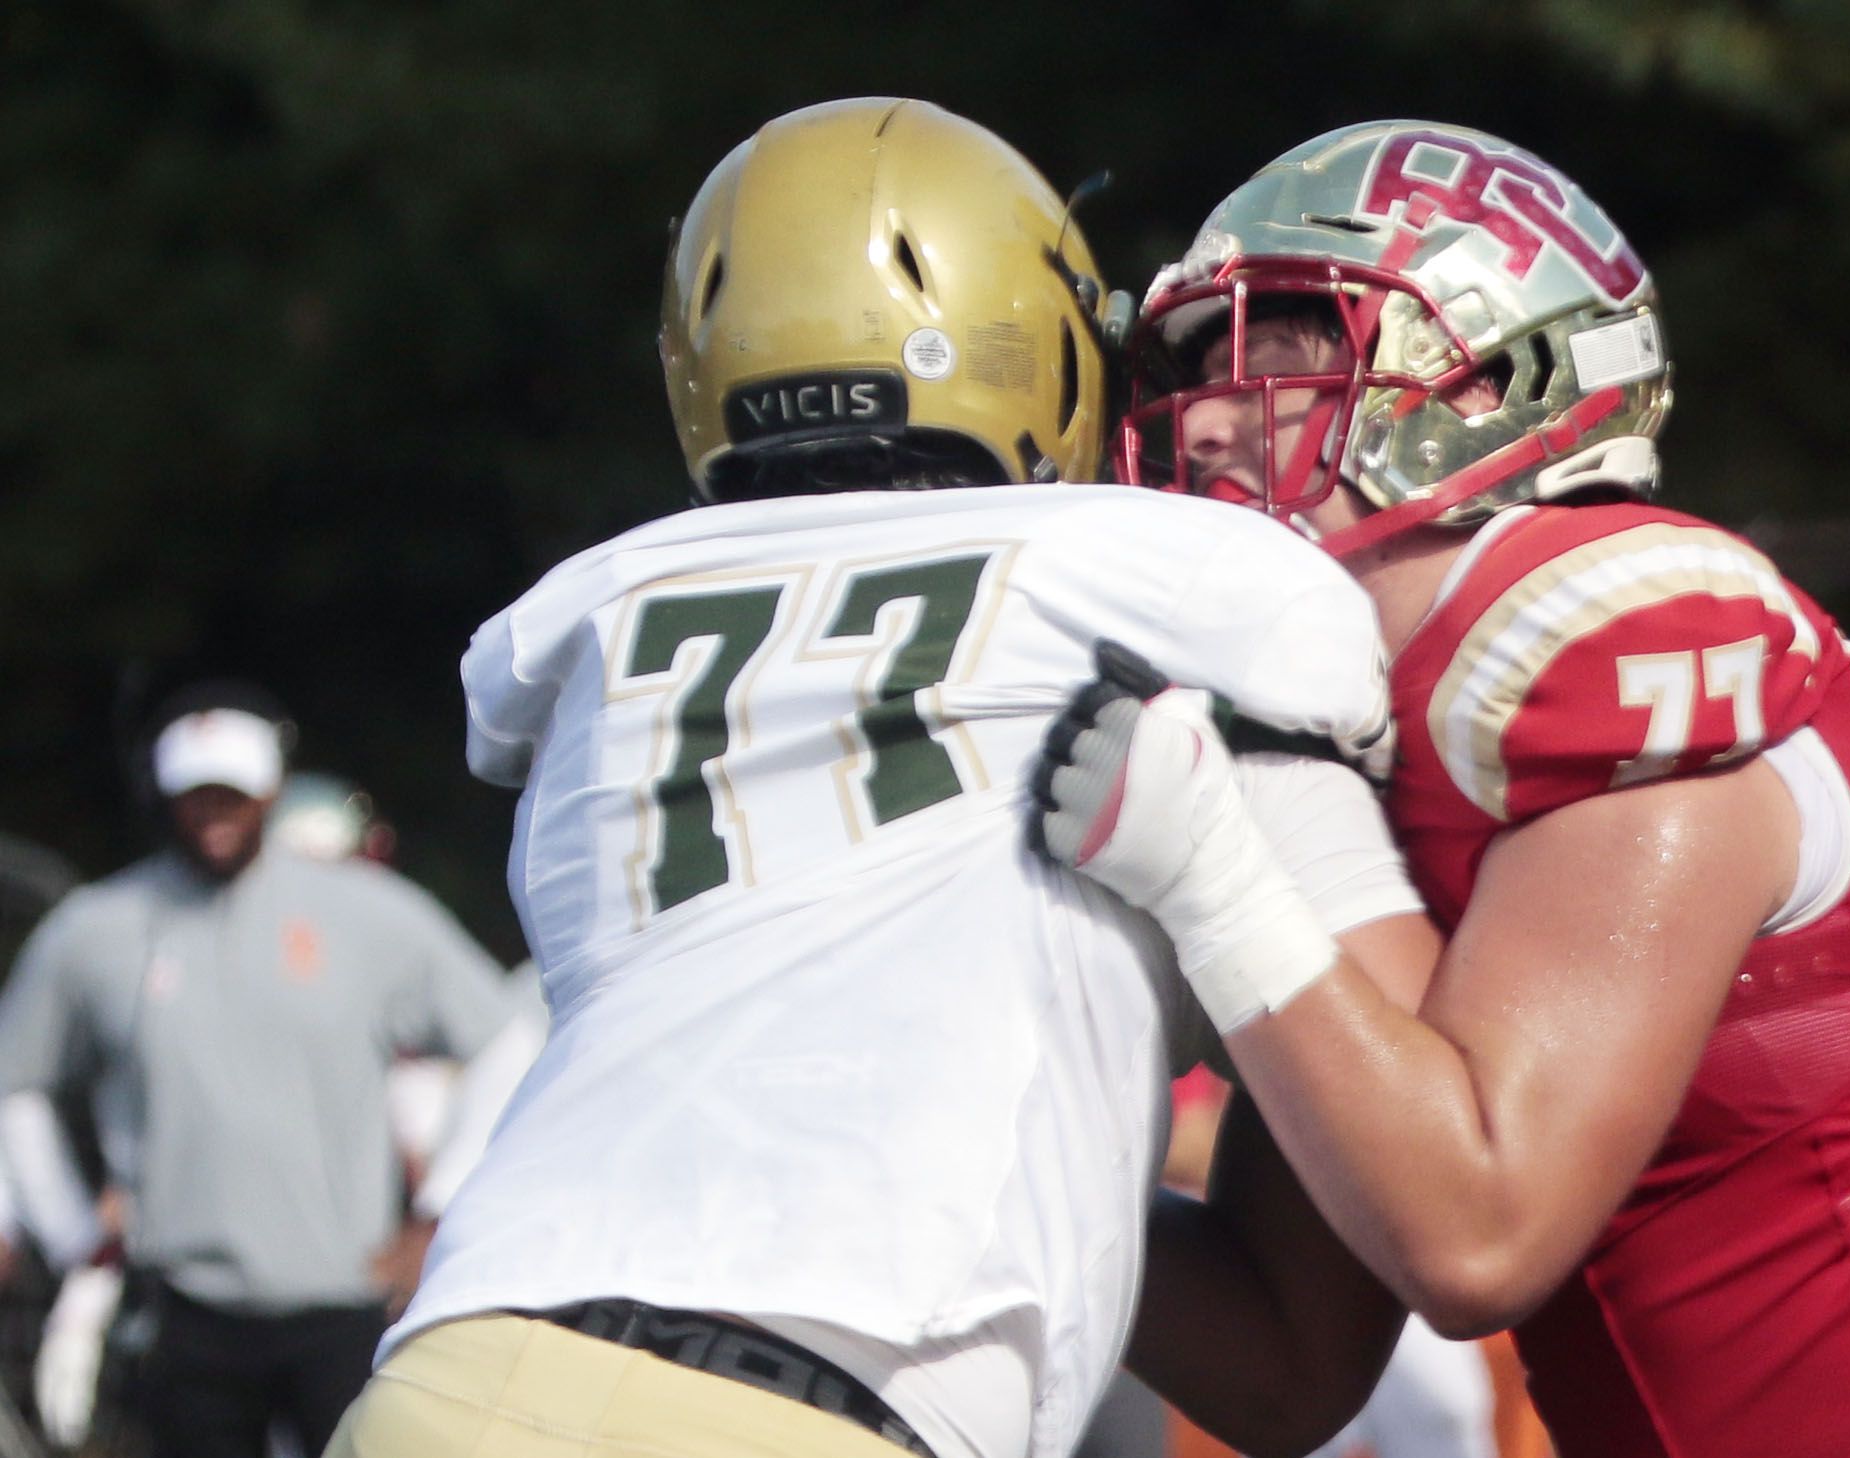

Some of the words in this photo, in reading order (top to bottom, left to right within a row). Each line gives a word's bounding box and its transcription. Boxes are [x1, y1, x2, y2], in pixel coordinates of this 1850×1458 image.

[742, 383, 879, 425] VICIS
[604, 538, 1027, 933] 77
[1608, 634, 1767, 790] 77
